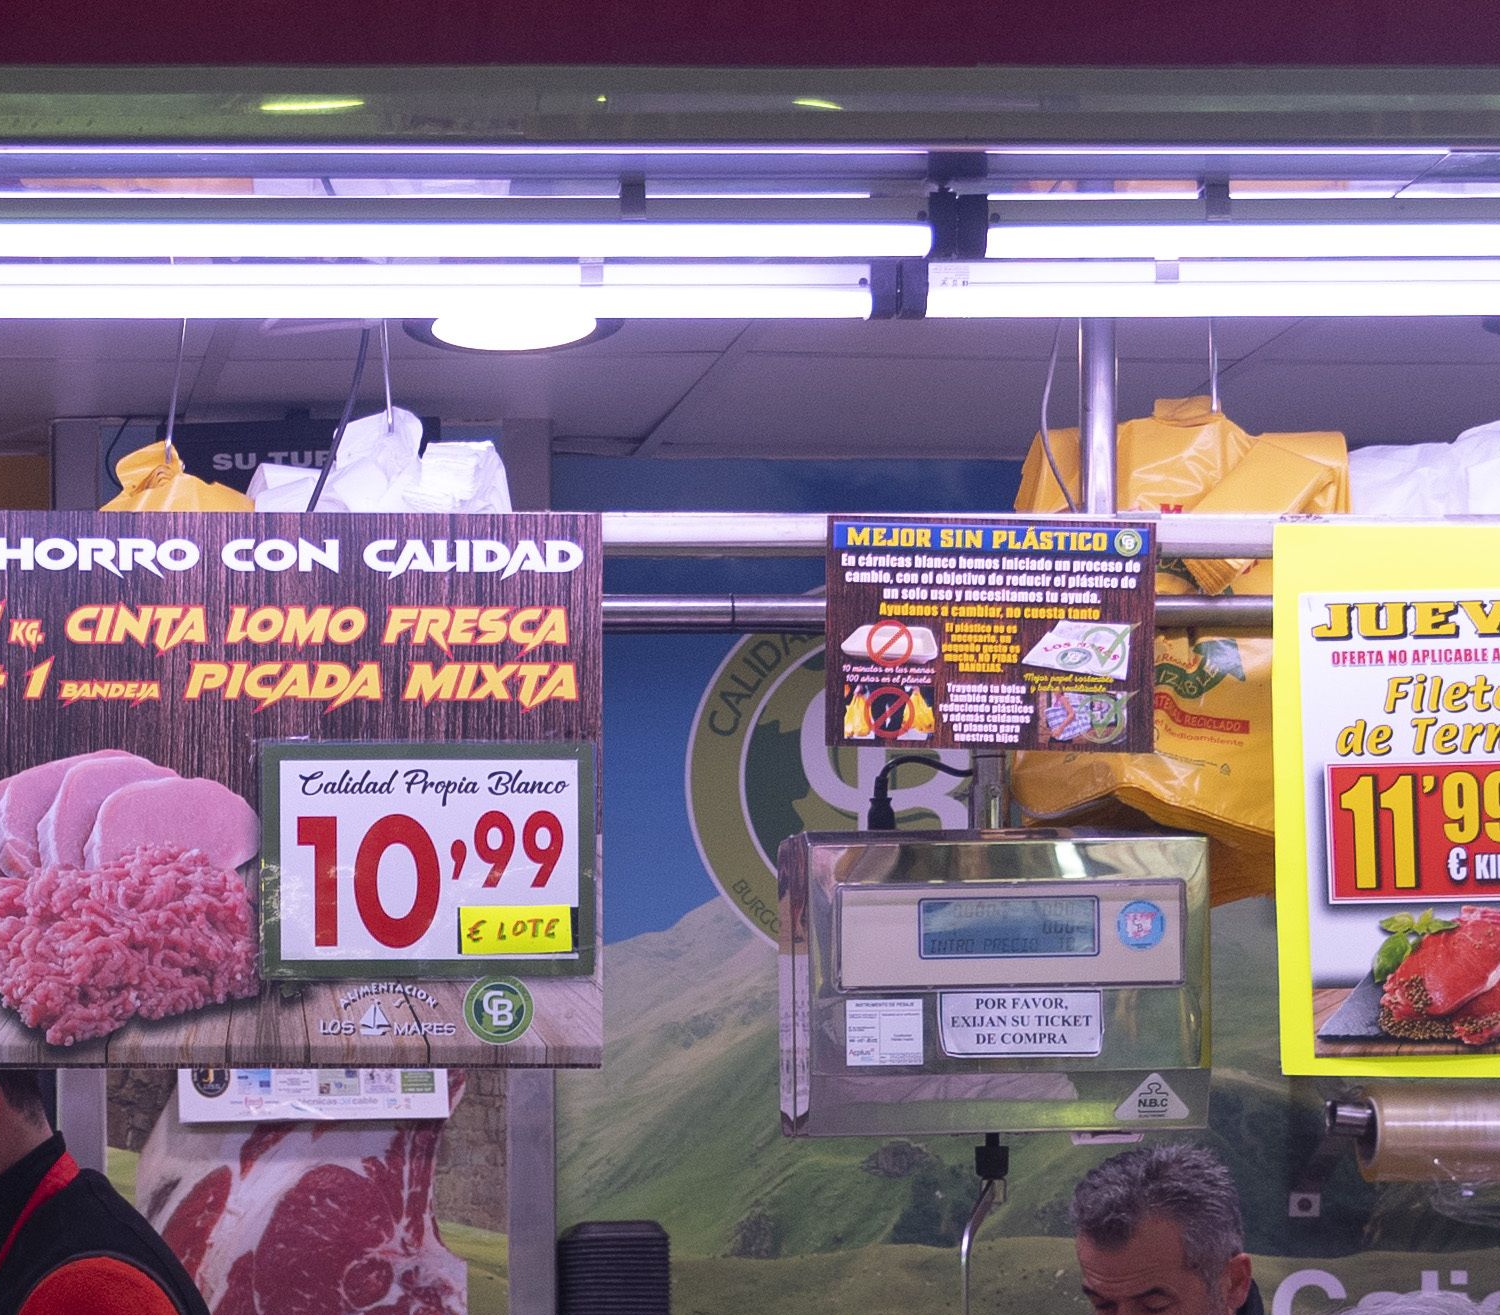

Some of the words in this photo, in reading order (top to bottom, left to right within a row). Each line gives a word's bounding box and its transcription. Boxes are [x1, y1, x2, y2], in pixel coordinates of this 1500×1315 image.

[847, 527, 931, 548] MEJOR
[940, 529, 983, 549] SIN
[992, 526, 1108, 552] PLÁSTICO
[222, 537, 339, 575] CON
[363, 538, 583, 580] CALIDAD
[1024, 606, 1065, 620] cuesta
[1067, 606, 1100, 620] tanto
[8, 619, 44, 650] KG.
[64, 604, 206, 656] CINTA
[224, 606, 367, 646] LOMO
[383, 606, 570, 658] FRESCA
[1331, 650, 1384, 667] OFERTA
[1388, 649, 1408, 665] NO
[1412, 647, 1488, 665] APLICABLE
[1492, 647, 1500, 663] A
[23, 655, 56, 700] 1
[58, 678, 161, 708] BANDEJA
[184, 661, 383, 714] PICADA
[402, 661, 580, 713] MIXTA
[1336, 719, 1394, 757] de
[299, 769, 397, 798] Calidad
[404, 770, 479, 807] Propia
[486, 771, 571, 796] Blanco
[1447, 847, 1467, 882] €
[497, 917, 560, 941] LOTE
[975, 998, 1008, 1010] POR
[1012, 998, 1068, 1011] FAVOR,
[319, 1019, 355, 1037] LOS
[392, 1020, 456, 1037] MARES
[951, 1015, 1007, 1029] EXIJAN
[1011, 1015, 1031, 1028] SU
[1036, 1015, 1093, 1028] TICKET
[976, 1033, 997, 1045] DE
[1000, 1032, 1068, 1045] COMPRA
